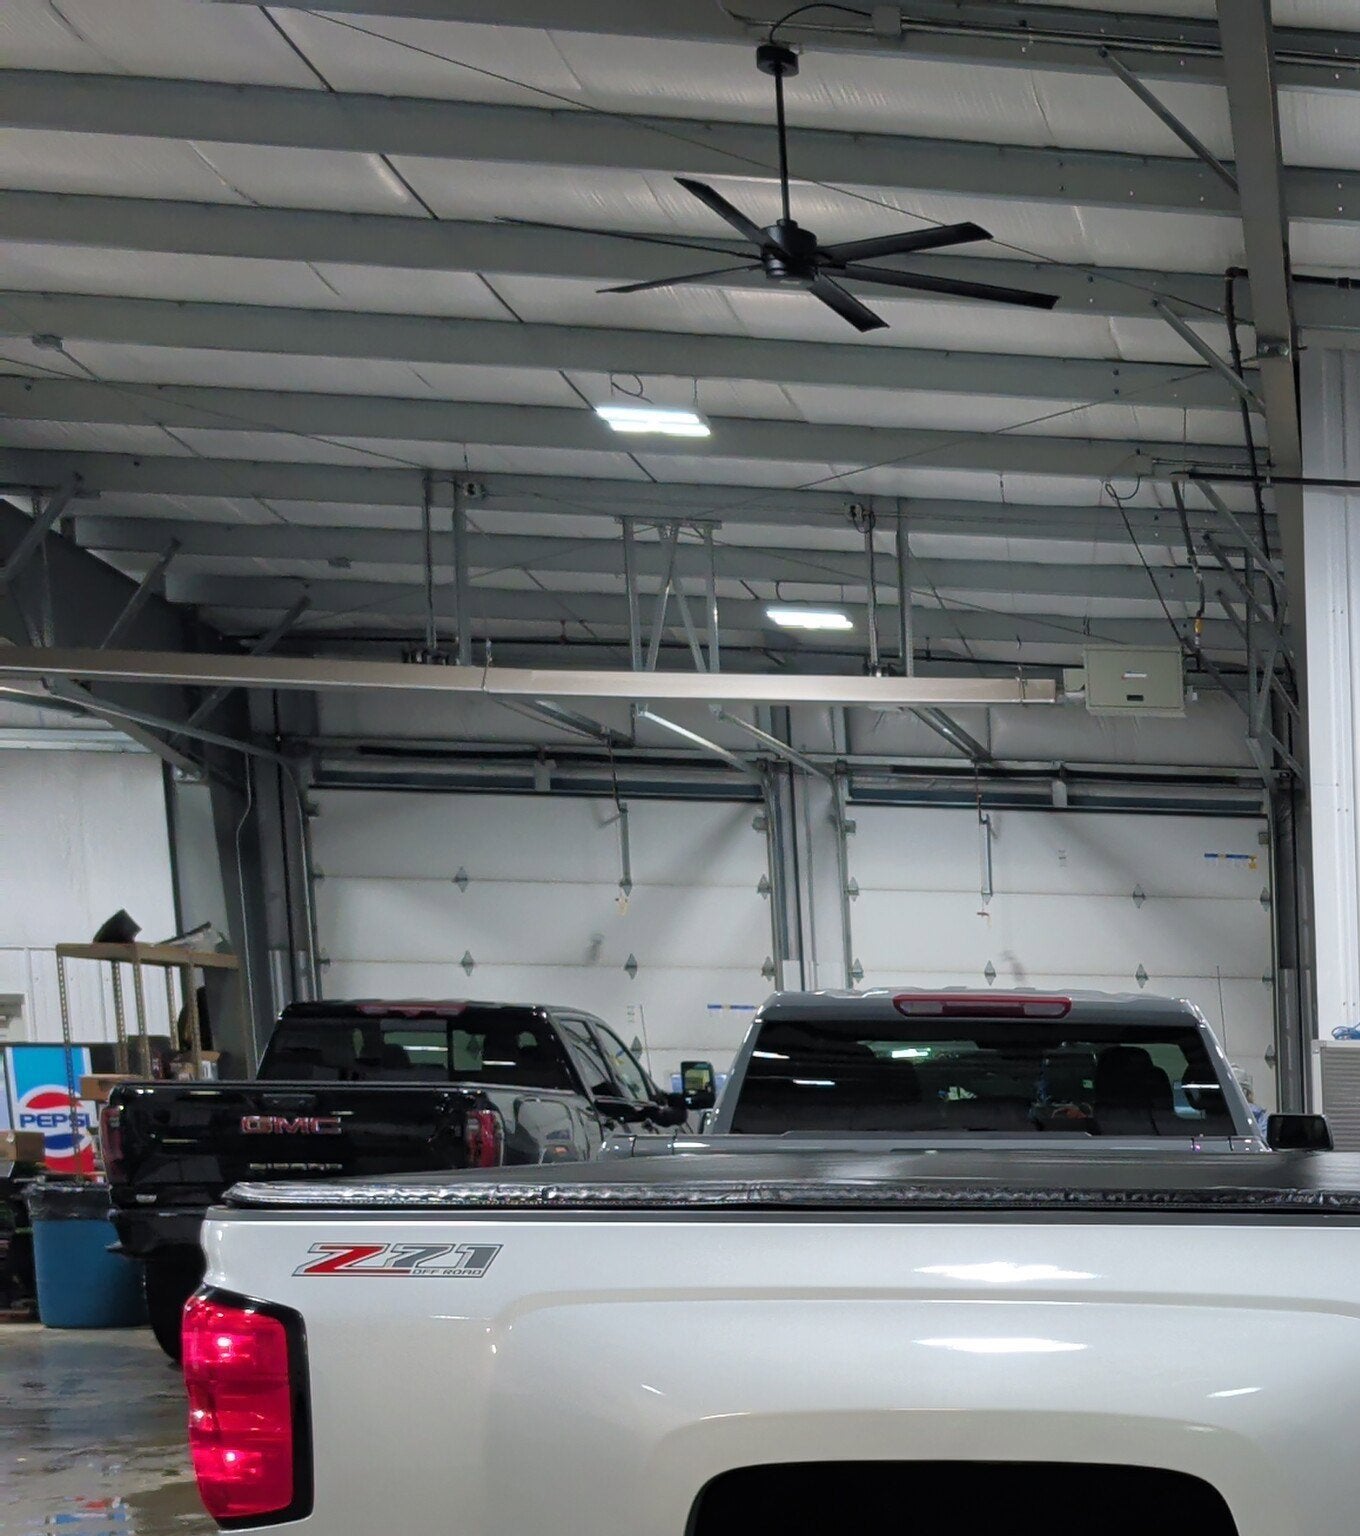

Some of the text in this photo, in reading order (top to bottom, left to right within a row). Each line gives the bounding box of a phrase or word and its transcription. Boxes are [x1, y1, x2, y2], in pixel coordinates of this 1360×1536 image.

[20, 1113, 91, 1128] PEPSI
[241, 1115, 342, 1134] GMC
[292, 1243, 503, 1277] Z71
